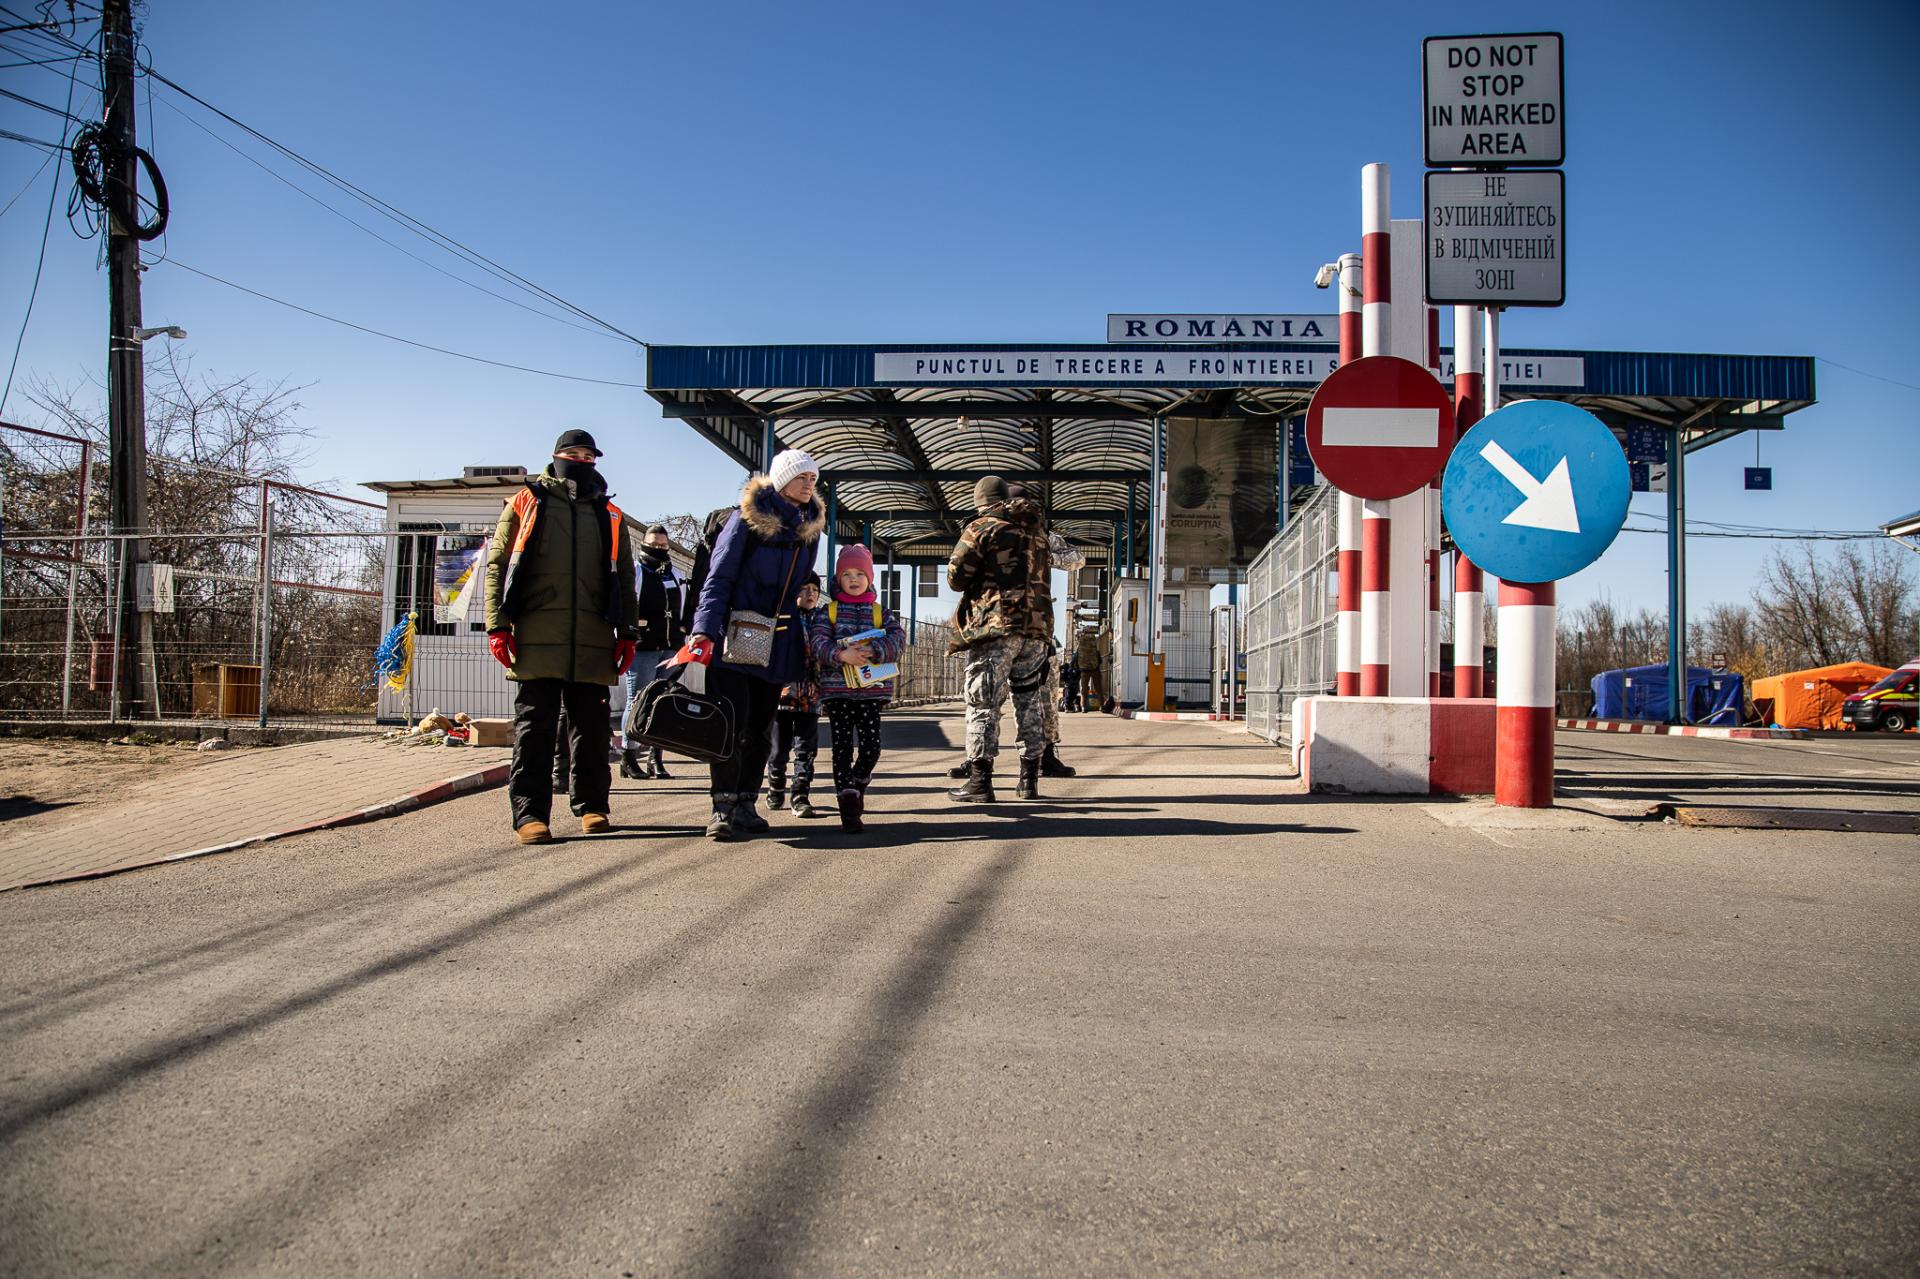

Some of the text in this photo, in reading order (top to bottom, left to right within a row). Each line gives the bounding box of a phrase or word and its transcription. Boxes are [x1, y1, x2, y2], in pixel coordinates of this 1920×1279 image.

[1448, 44, 1538, 68] DO NOT
[1462, 74, 1524, 97] STOP
[1432, 103, 1556, 126] IN MARKED
[1461, 132, 1527, 155] AREA
[1484, 176, 1507, 197] НЕ
[1433, 202, 1556, 227] ЗУПИНЯЙТЕСЬ
[1434, 235, 1556, 263] В ВІДМІЧЕНІЙ
[1475, 268, 1515, 290] ЗОНІ
[916, 358, 1005, 375] PUNCTUL
[1016, 358, 1039, 375] DE
[1055, 358, 1144, 375] TRECERE
[1154, 359, 1165, 374] A
[1189, 359, 1313, 375] FRONTIEREI
